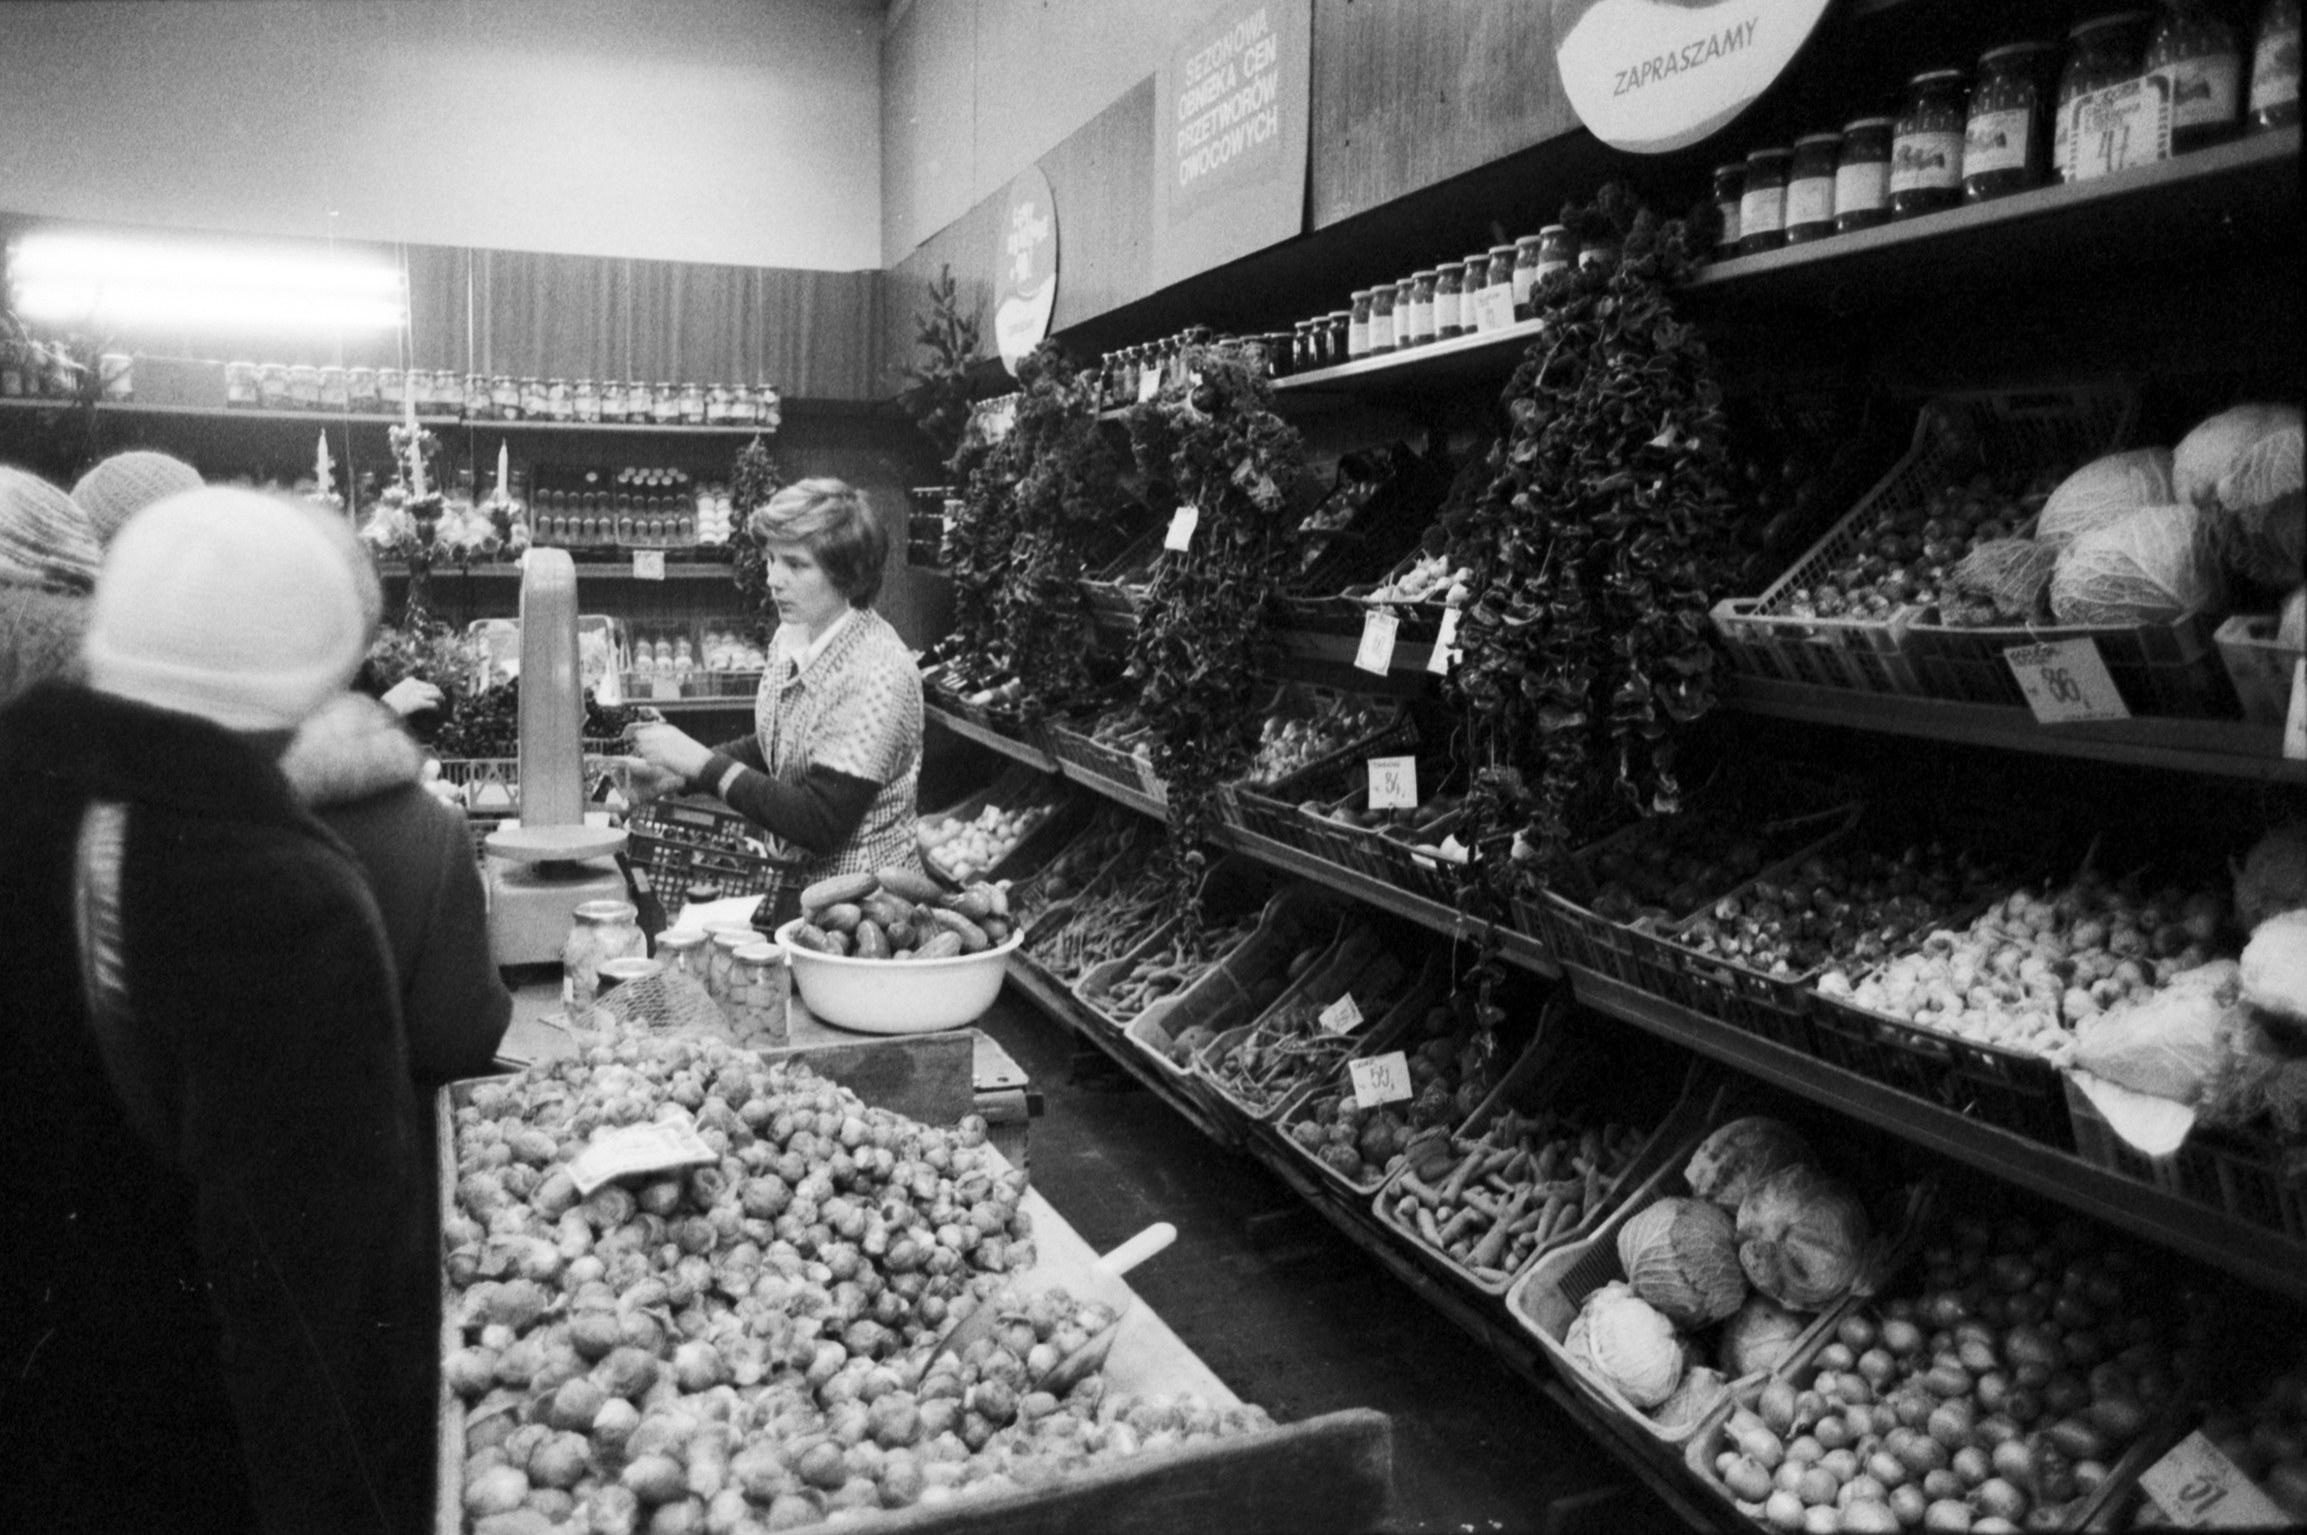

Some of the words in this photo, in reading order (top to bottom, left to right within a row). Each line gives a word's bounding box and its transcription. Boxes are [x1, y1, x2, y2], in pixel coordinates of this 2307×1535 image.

[1185, 8, 1268, 86] SEZONOWA
[1243, 33, 1277, 79] CEN
[1613, 16, 1759, 97] ZAPRASZAMY
[1177, 69, 1278, 157] PRZETWORÓW
[1179, 105, 1278, 186] OWOCOWYCH
